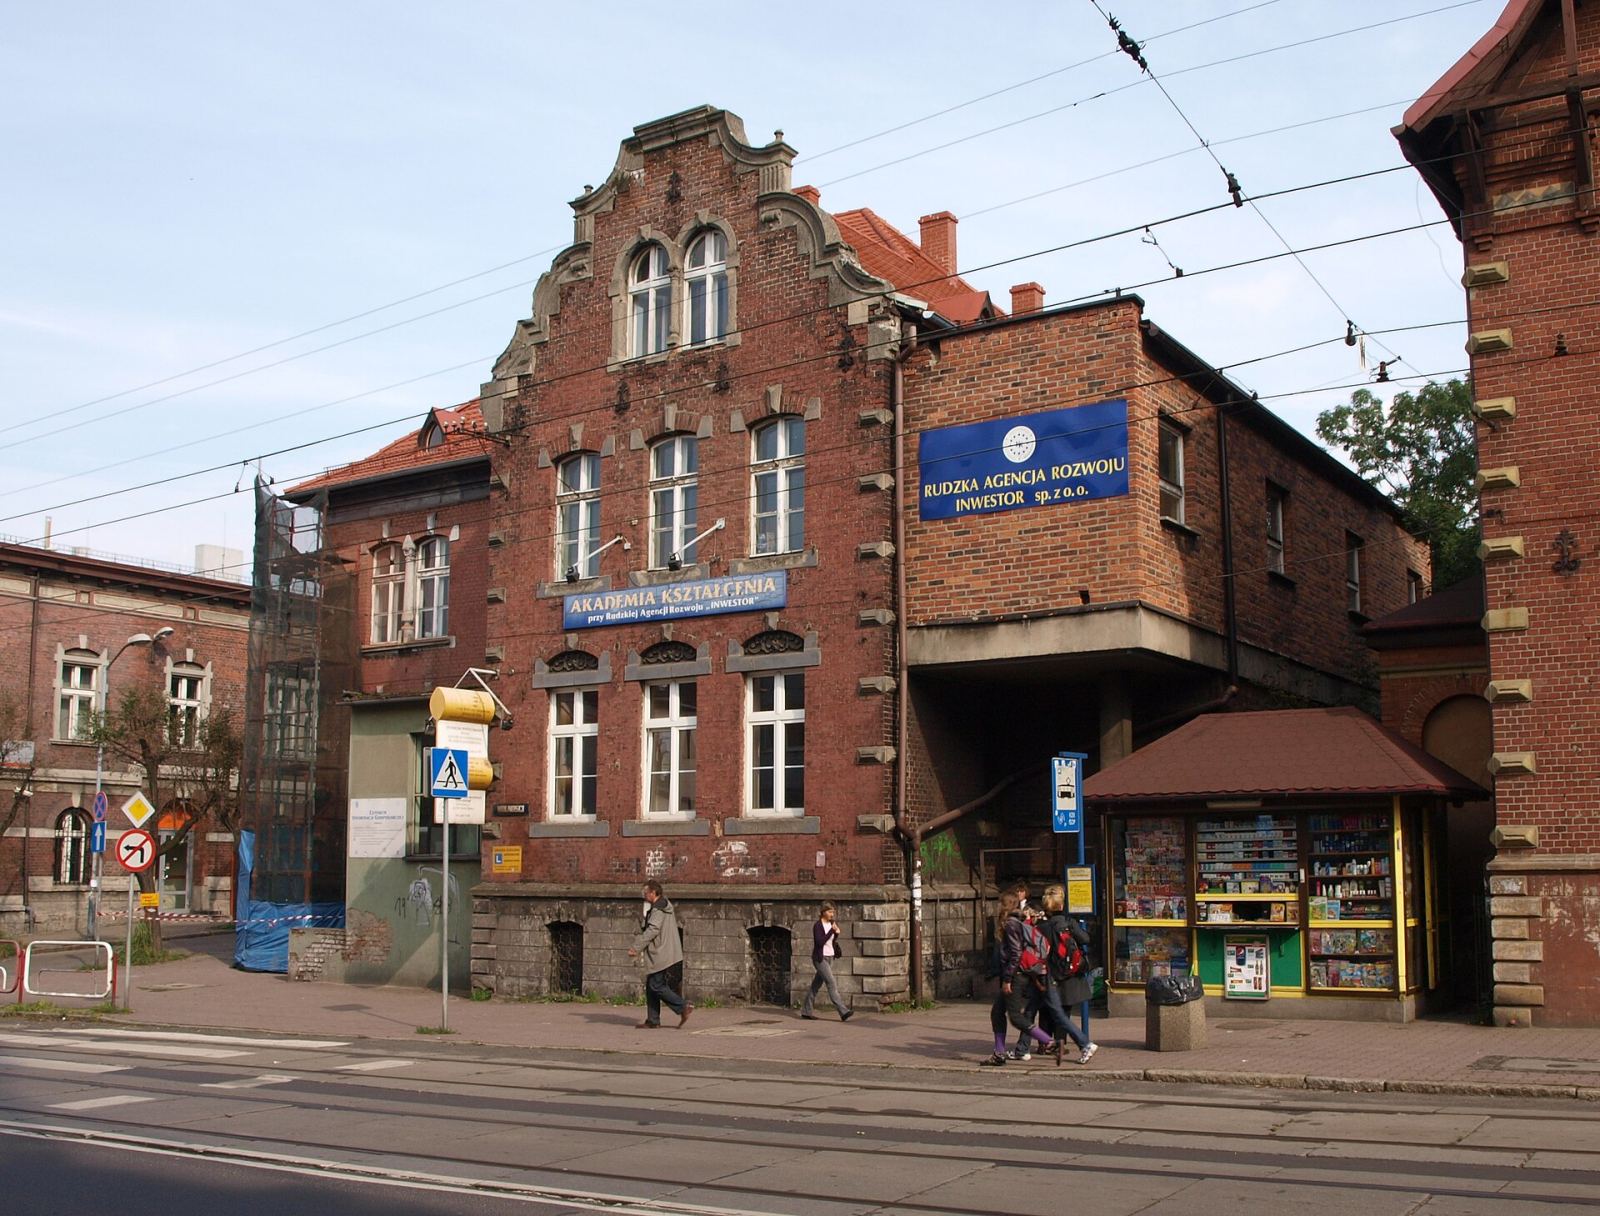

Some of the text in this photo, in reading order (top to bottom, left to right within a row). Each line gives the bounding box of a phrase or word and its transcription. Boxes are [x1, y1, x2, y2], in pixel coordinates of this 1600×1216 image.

[924, 456, 1125, 497] RUDZKA AGENCJA ROZWOJU
[955, 490, 1025, 512] INWESTOR
[1034, 490, 1052, 505] sp.
[1053, 488, 1061, 499] z
[570, 577, 776, 613] AKADEMIA KSZTAŁCENIA
[587, 613, 604, 624] przy
[639, 606, 669, 618] Agencji
[669, 604, 704, 614] Rozwoju
